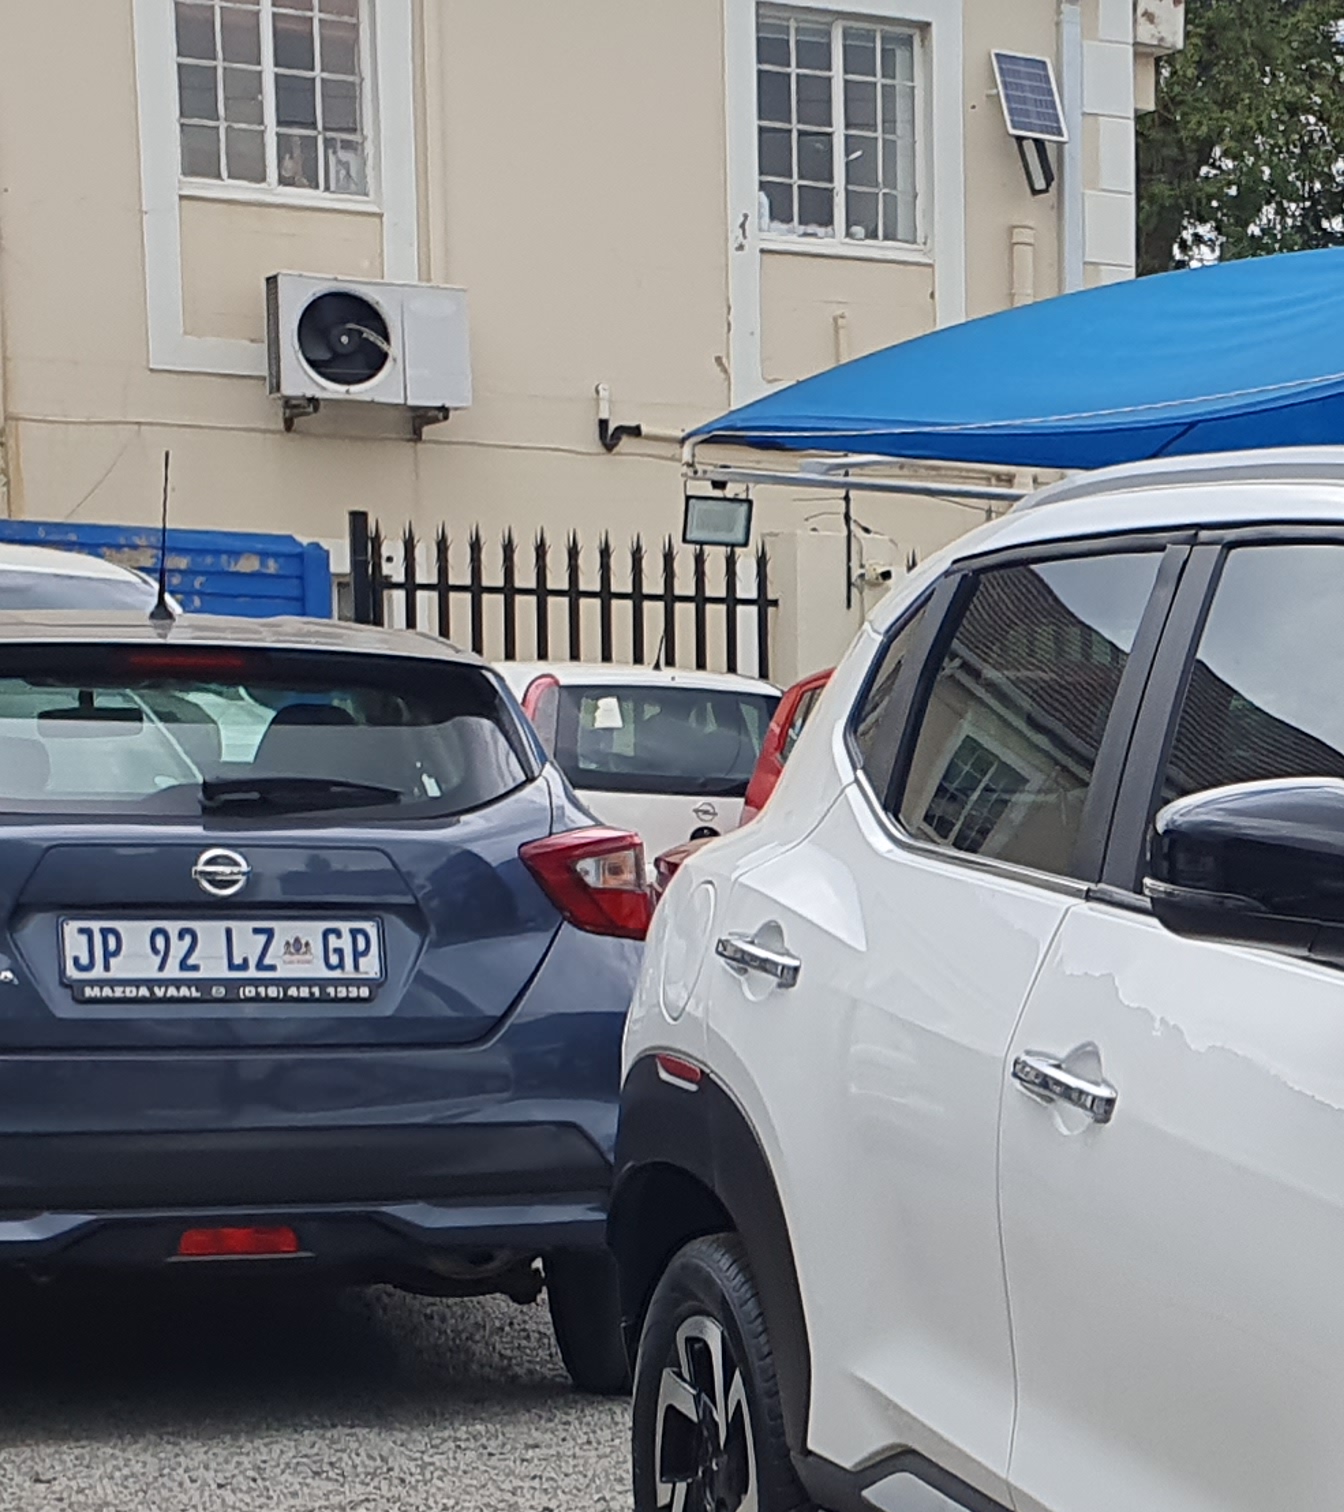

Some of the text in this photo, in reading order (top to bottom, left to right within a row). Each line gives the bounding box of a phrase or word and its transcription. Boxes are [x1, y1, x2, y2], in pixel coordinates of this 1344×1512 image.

[72, 926, 372, 973] JP 92 LZ GP
[153, 985, 201, 998] VAAL
